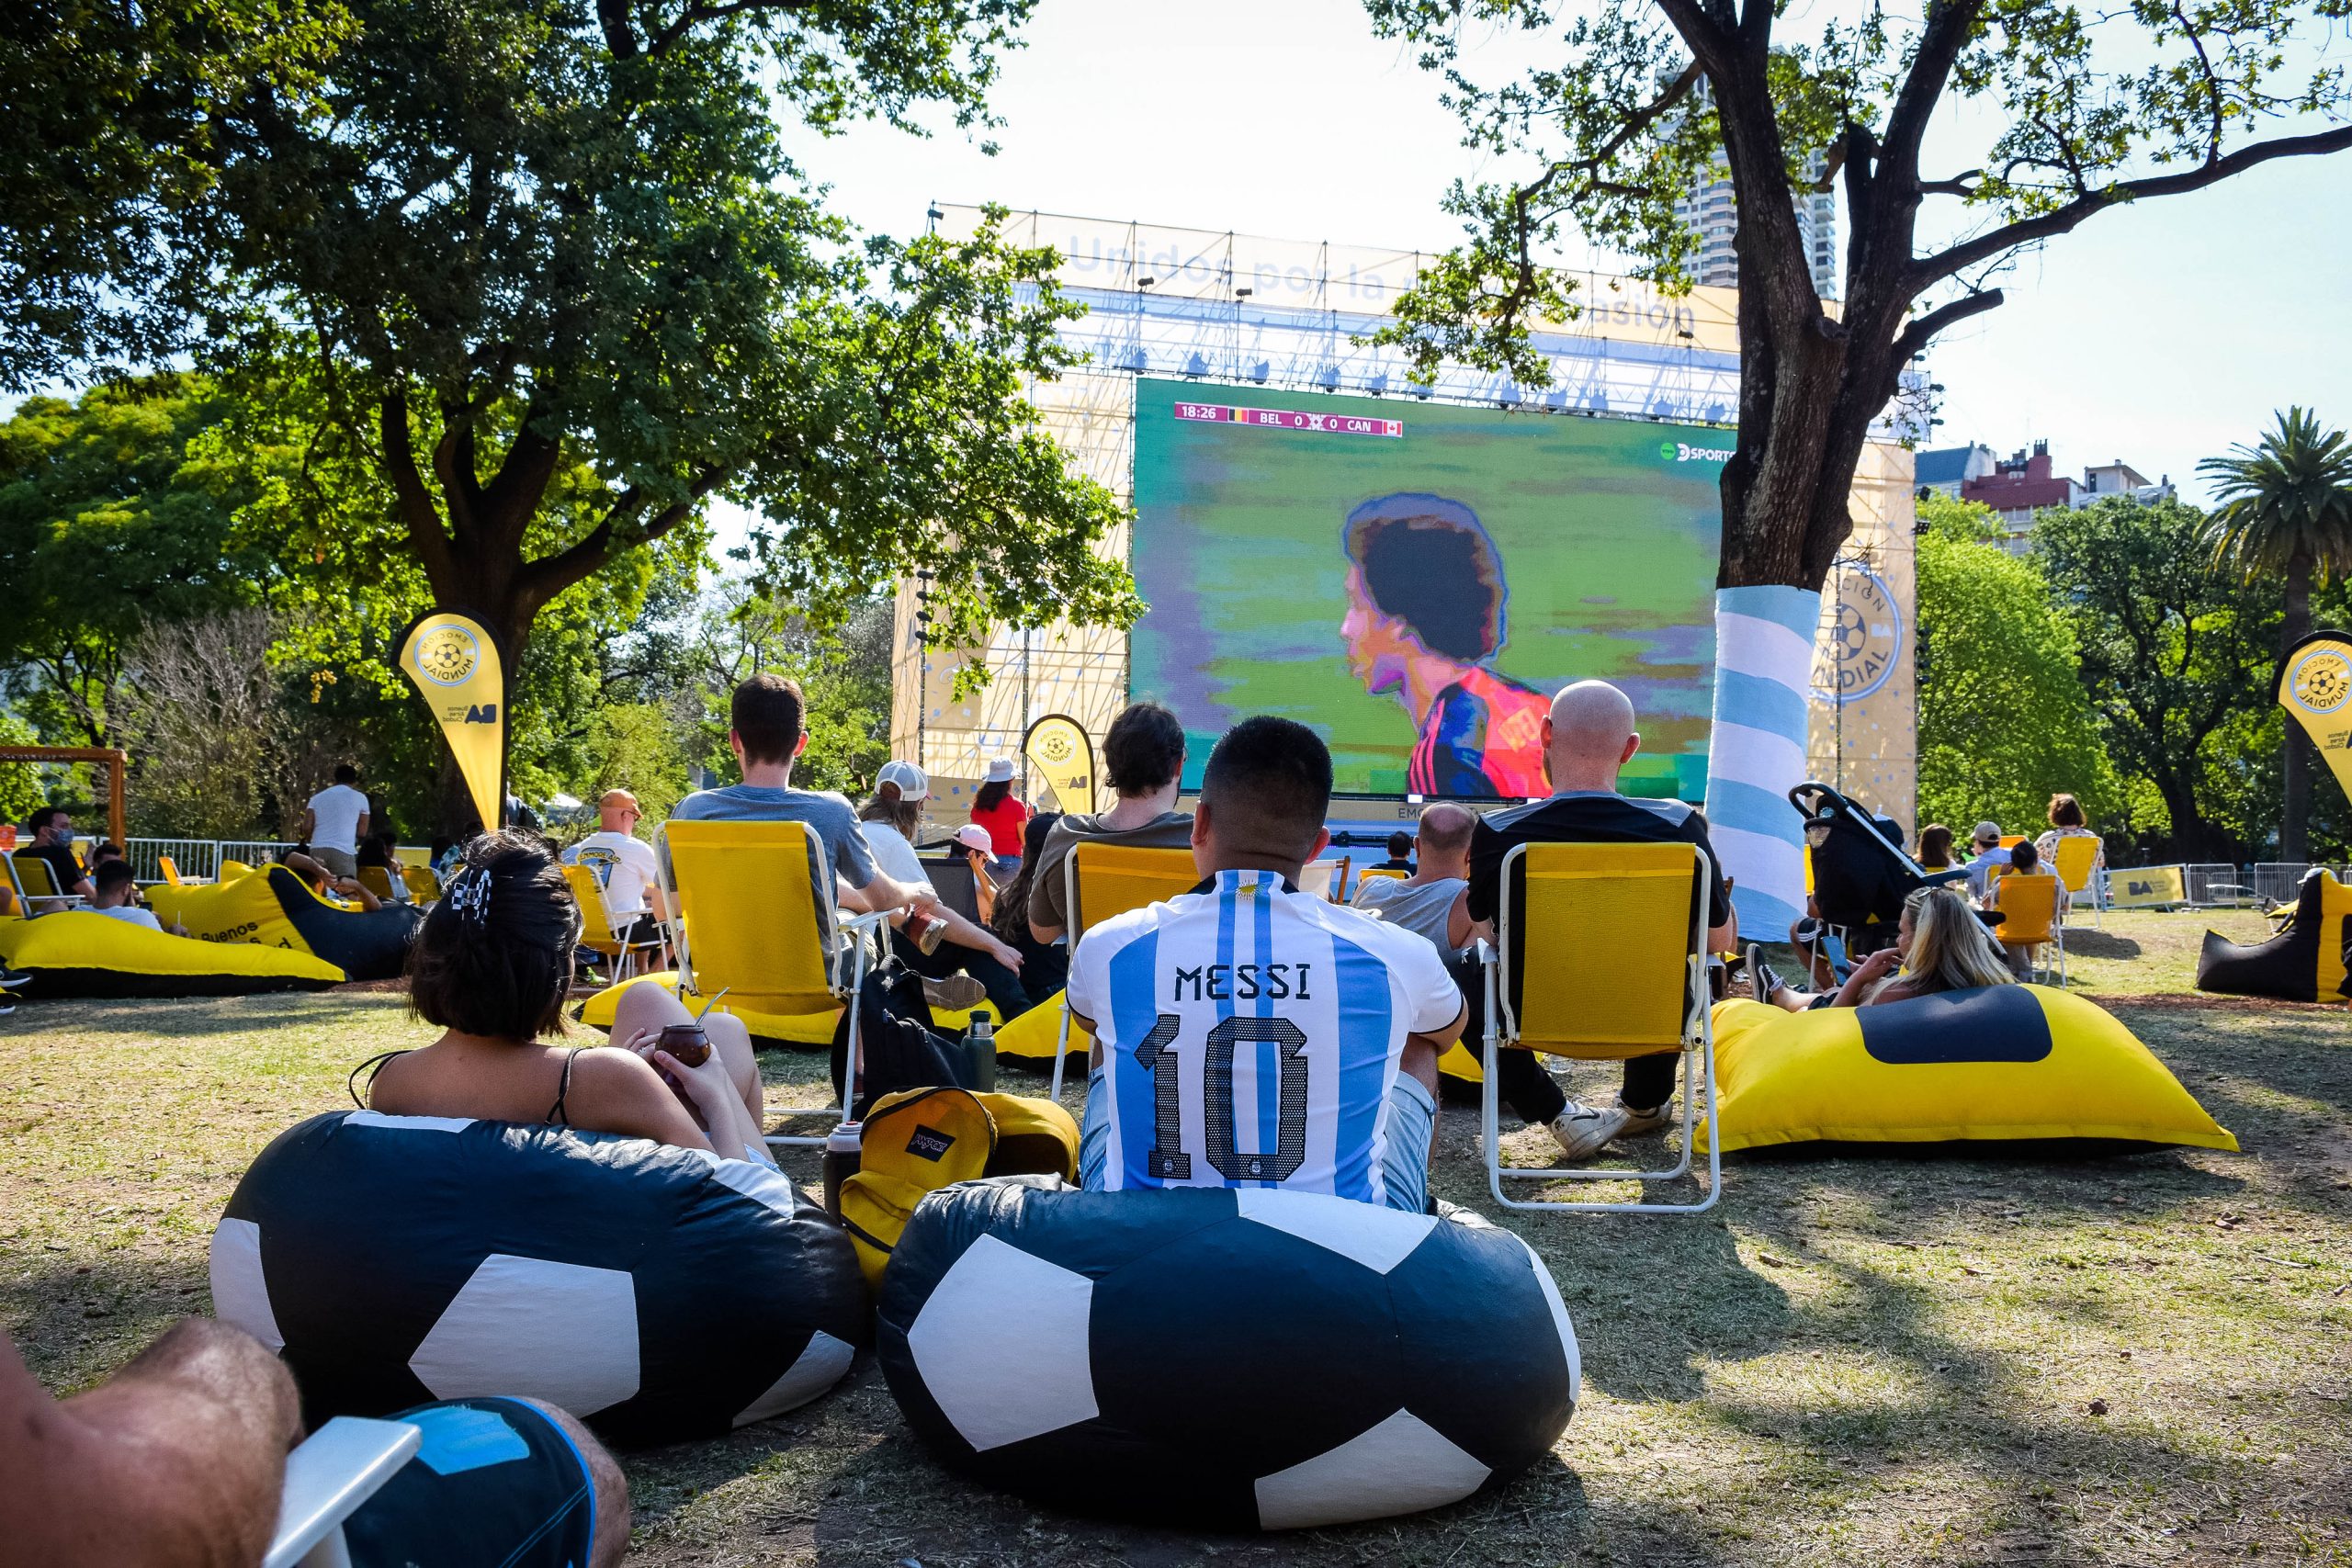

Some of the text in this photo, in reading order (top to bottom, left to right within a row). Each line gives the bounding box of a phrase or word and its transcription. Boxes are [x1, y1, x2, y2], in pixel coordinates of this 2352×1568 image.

[1070, 235, 1228, 284] Unidos
[1254, 261, 1331, 296] por
[1349, 263, 1385, 300] la
[1182, 405, 1372, 432] 18:26 BEL 0 0 CAN
[201, 921, 259, 943] Buenos
[1175, 964, 1311, 1001] MESSI
[1134, 1014, 1308, 1181] 10
